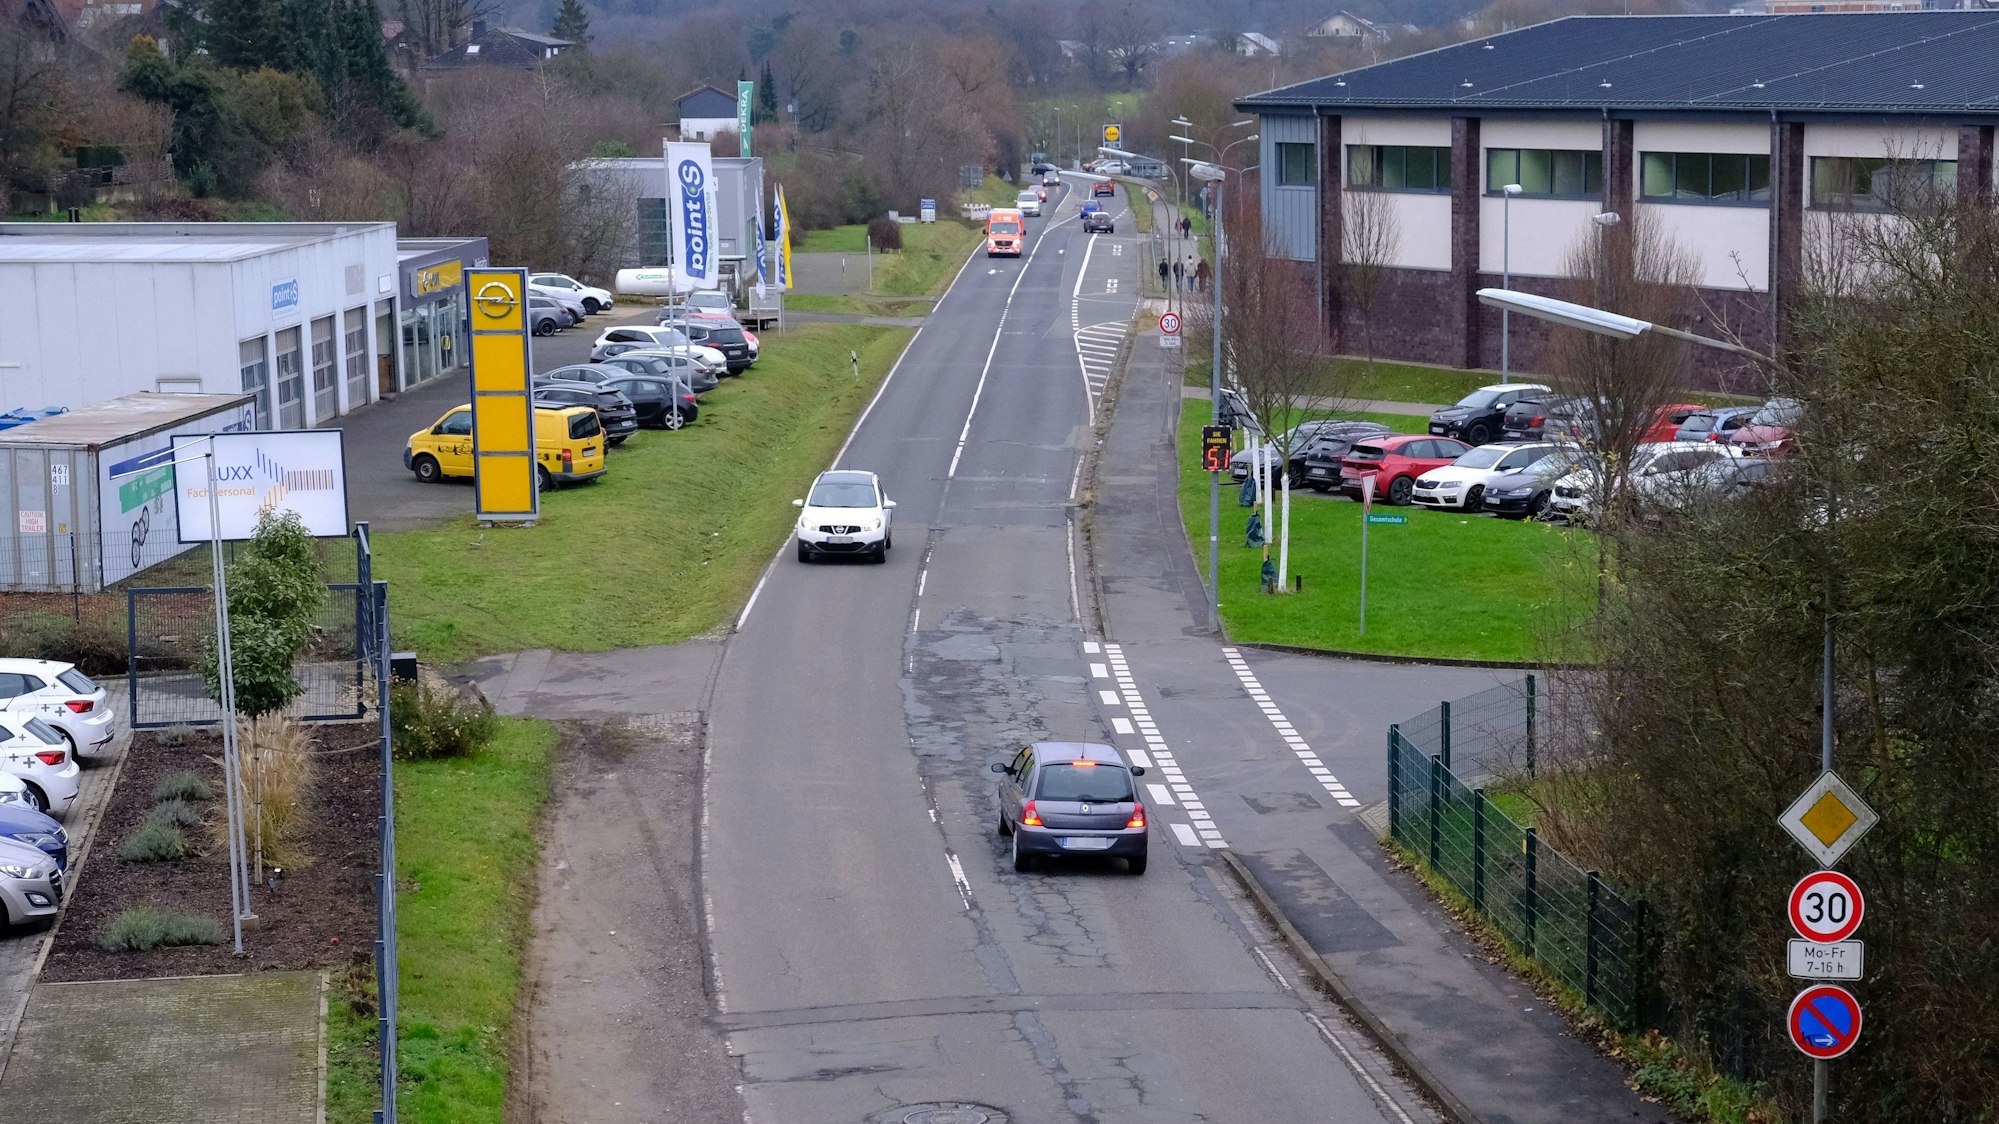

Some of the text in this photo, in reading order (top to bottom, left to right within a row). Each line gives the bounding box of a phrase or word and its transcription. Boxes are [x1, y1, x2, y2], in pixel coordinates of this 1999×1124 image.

[740, 89, 749, 132] DEKRA
[682, 164, 704, 271] point S
[273, 287, 291, 307] point
[1163, 318, 1177, 329] 30
[1207, 448, 1230, 470] 51
[52, 465, 68, 475] 467
[52, 475, 67, 484] 411
[187, 486, 255, 498] Fachersonal
[1805, 892, 1847, 923] 30
[1804, 947, 1846, 959] Mo-Fr
[1807, 961, 1844, 973] 7-16 h
